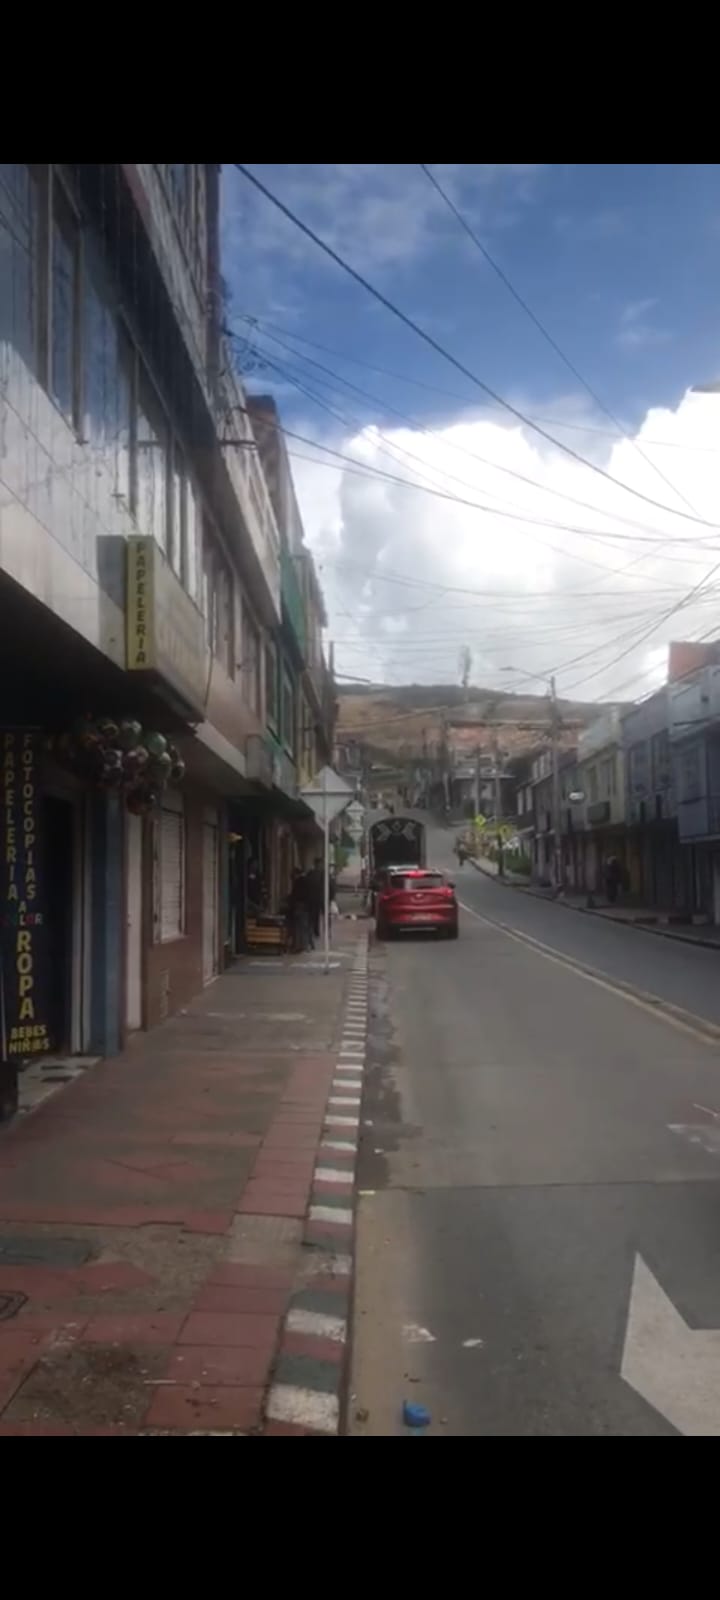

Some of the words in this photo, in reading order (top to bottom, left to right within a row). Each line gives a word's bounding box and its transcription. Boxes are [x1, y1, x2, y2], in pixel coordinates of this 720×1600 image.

[136, 542, 146, 663] PAPELERIA
[4, 733, 19, 900] PAPELERIA
[22, 734, 37, 899] FOTOCOPIAS
[10, 1025, 47, 1040] BEBES
[16, 931, 34, 1019] ROPA
